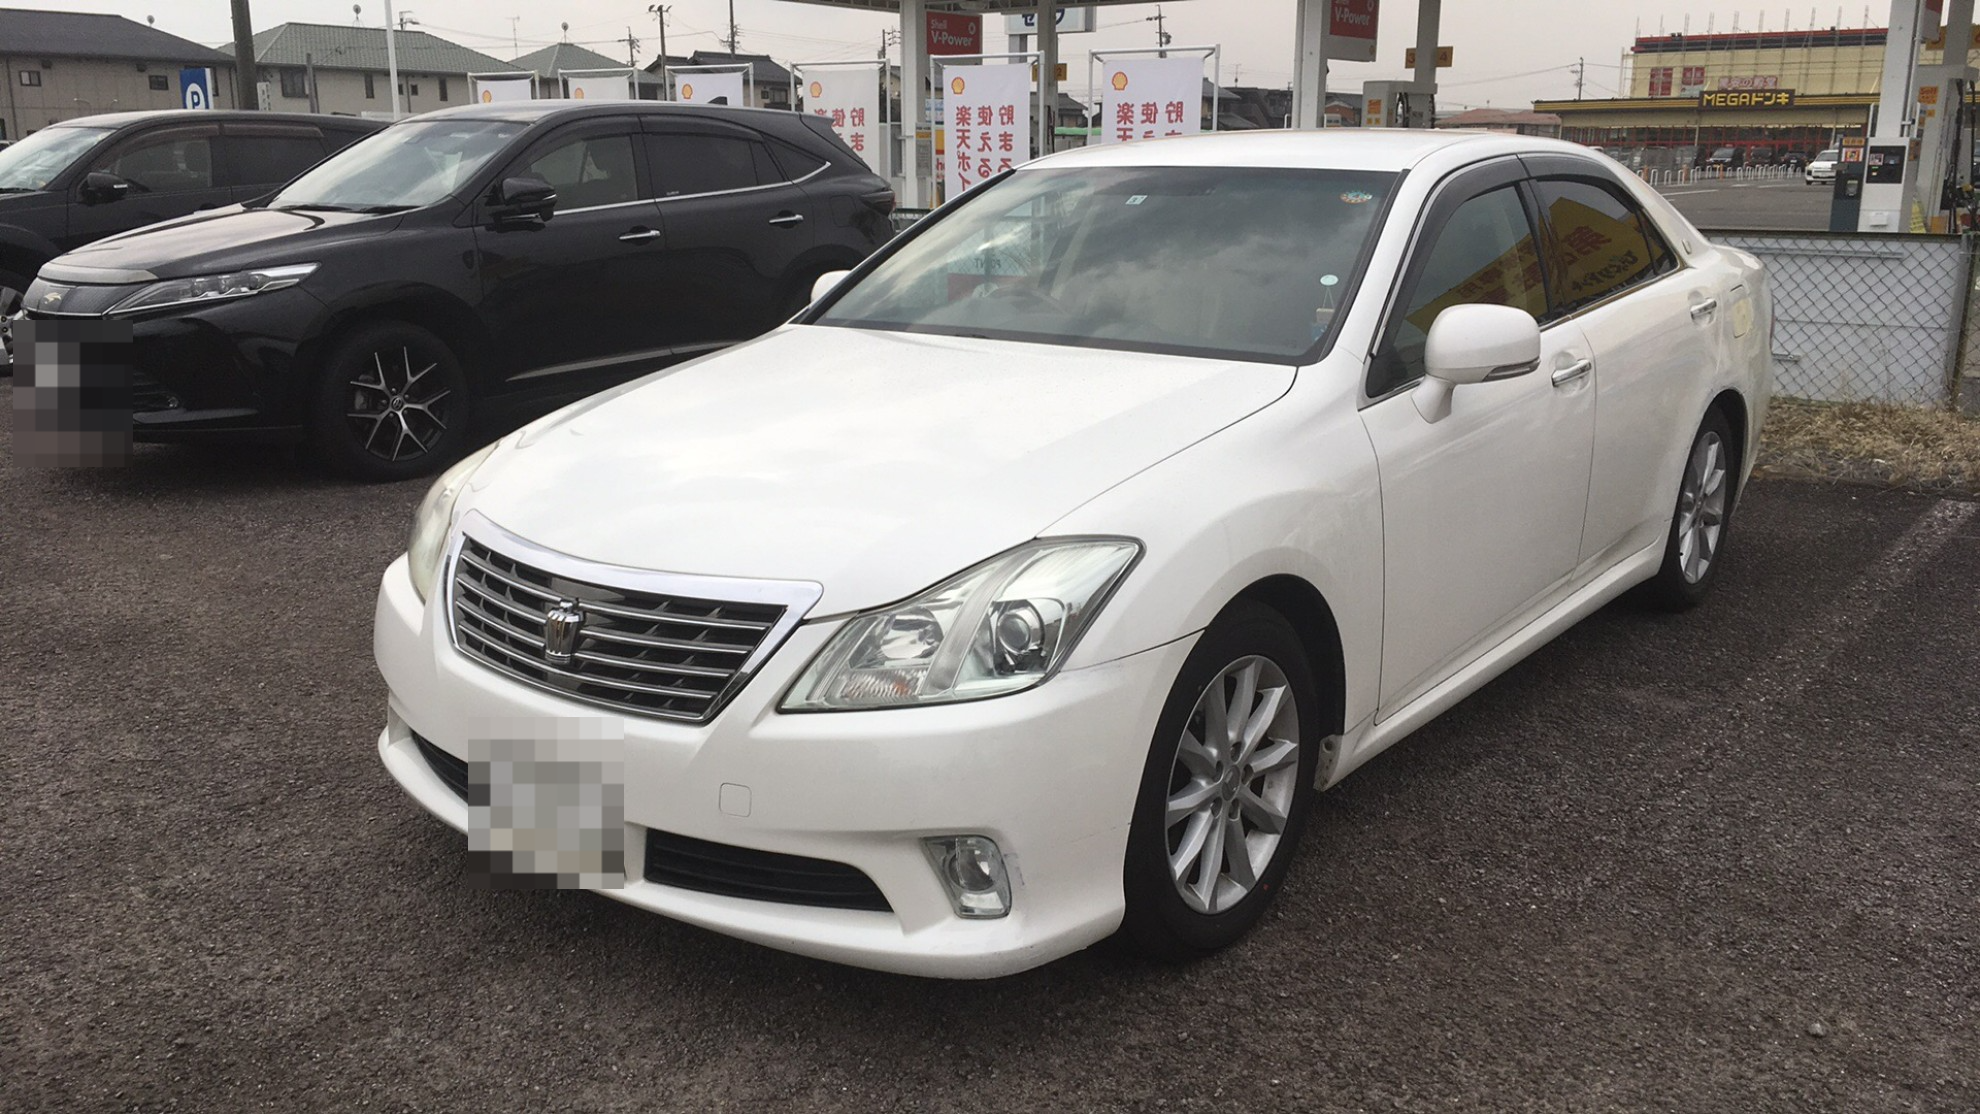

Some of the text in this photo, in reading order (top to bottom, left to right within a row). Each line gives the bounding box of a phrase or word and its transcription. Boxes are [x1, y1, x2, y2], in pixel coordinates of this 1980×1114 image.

[931, 19, 947, 29] Shell
[931, 30, 973, 46] V-Power
[190, 91, 201, 109] P
[1702, 92, 1790, 107] MEGAドンキ
